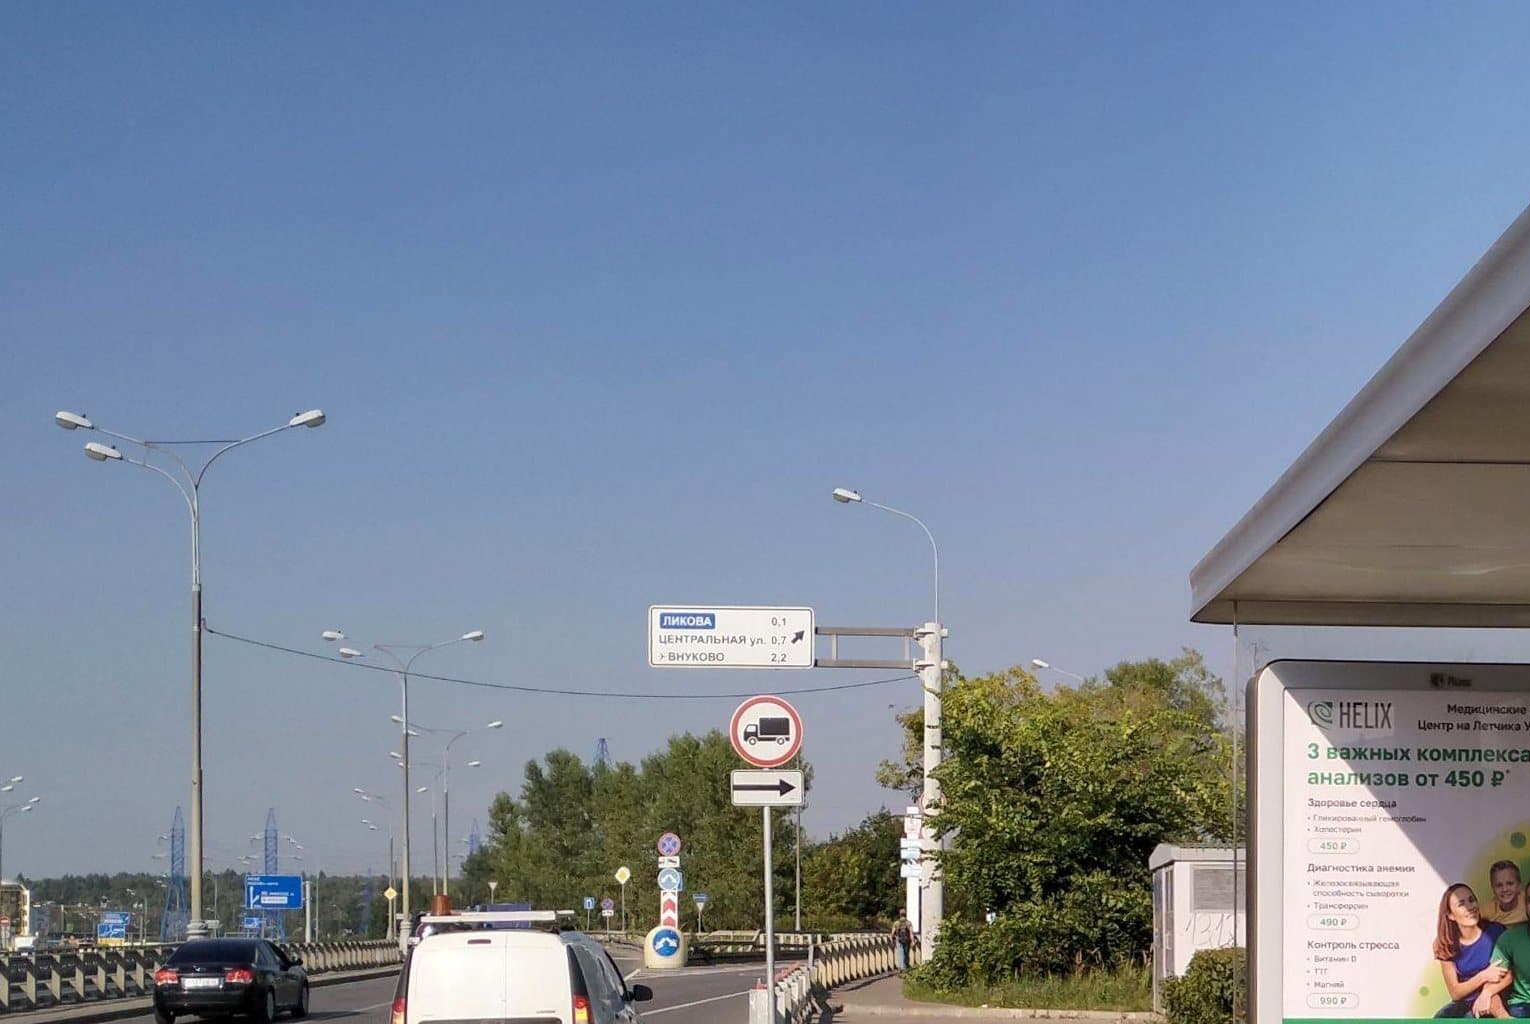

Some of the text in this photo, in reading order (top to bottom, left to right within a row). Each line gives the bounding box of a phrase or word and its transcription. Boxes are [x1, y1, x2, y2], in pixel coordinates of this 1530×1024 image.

[662, 615, 713, 627] ЛИКОВА
[771, 617, 787, 628] 0,1
[658, 634, 787, 647] ЦЕНТРАЛЬНАЯ ул. 0,7
[668, 652, 725, 662] ВНУКОВО
[770, 653, 787, 664] 2,2
[1339, 702, 1392, 729] HELIX
[1447, 704, 1527, 717] Медицинские
[1418, 720, 1454, 733] Центр
[1456, 722, 1471, 732] на
[1473, 721, 1521, 732] Летчика
[1307, 742, 1320, 760] 3
[1327, 747, 1411, 762] важных
[1307, 772, 1409, 787] анализов
[1415, 772, 1440, 787] от
[1444, 770, 1485, 787] 450
[1307, 798, 1397, 809] Здоровье сердца
[1319, 842, 1338, 850] 450
[1307, 863, 1416, 873] Диагностика анемии
[1319, 917, 1339, 926] 490
[1307, 940, 1401, 951] Контроль стресса
[1319, 996, 1339, 1006] 990
